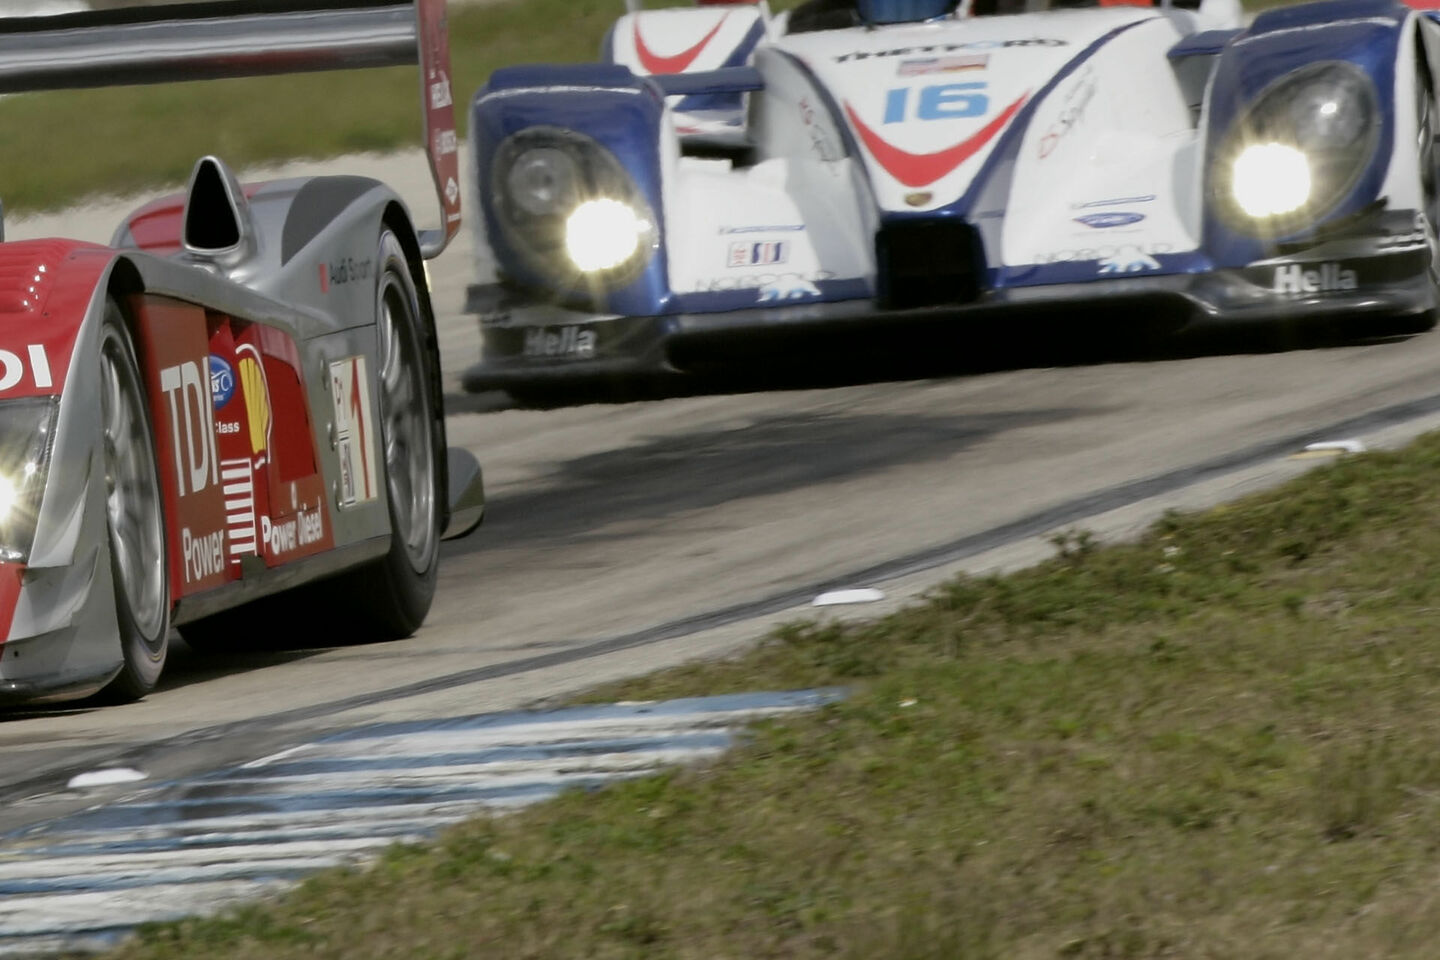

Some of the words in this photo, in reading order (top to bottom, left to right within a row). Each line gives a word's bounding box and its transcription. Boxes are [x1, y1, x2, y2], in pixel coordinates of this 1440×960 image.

[883, 82, 990, 125] 16
[1273, 262, 1358, 294] Hella
[524, 326, 596, 358] Hella
[160, 356, 219, 497] TDI
[182, 528, 226, 583] Power
